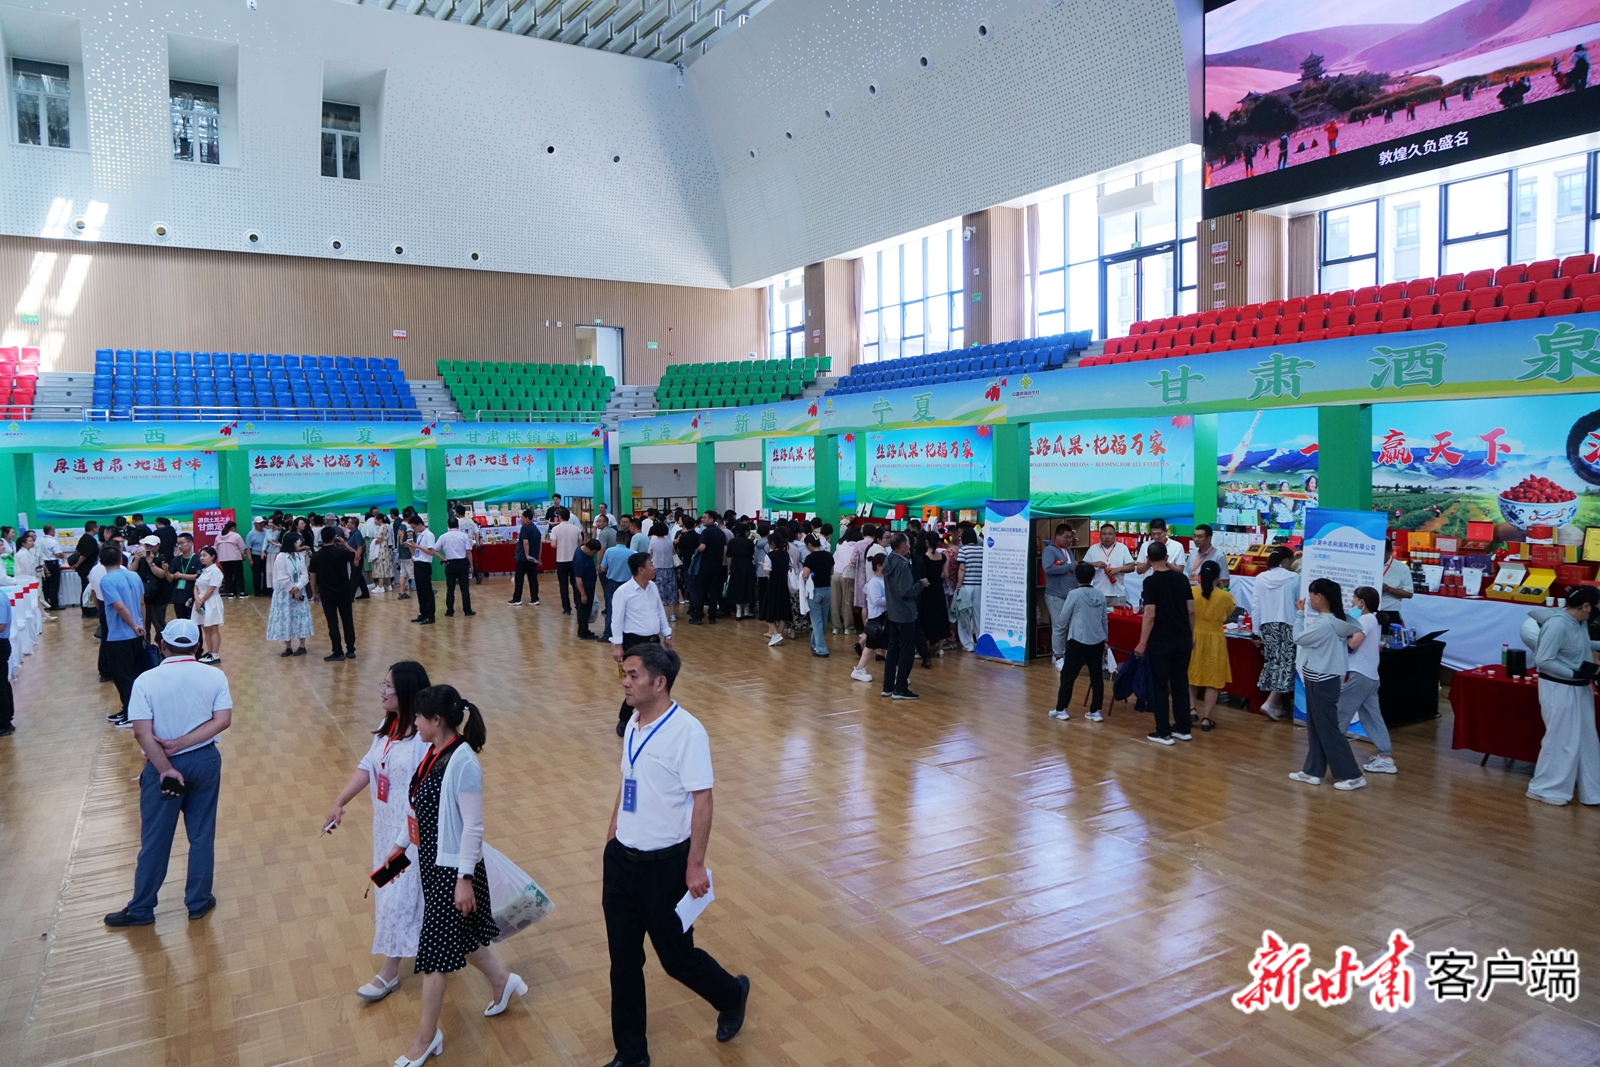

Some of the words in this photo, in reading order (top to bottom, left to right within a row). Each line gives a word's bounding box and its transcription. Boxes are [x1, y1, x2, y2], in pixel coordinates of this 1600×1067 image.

[1378, 131, 1468, 166] 敦煌久负盛名
[1146, 322, 1600, 404] 甘肃酒泉
[734, 408, 778, 435] 新疆
[871, 392, 936, 427] 宁夏
[80, 425, 166, 448] 定西
[302, 426, 376, 446] 临夏
[465, 428, 580, 444] 甘肃供销集团
[641, 420, 672, 442] 青海
[1378, 427, 1512, 466] 赢天下
[197, 523, 227, 531] 甘肃定
